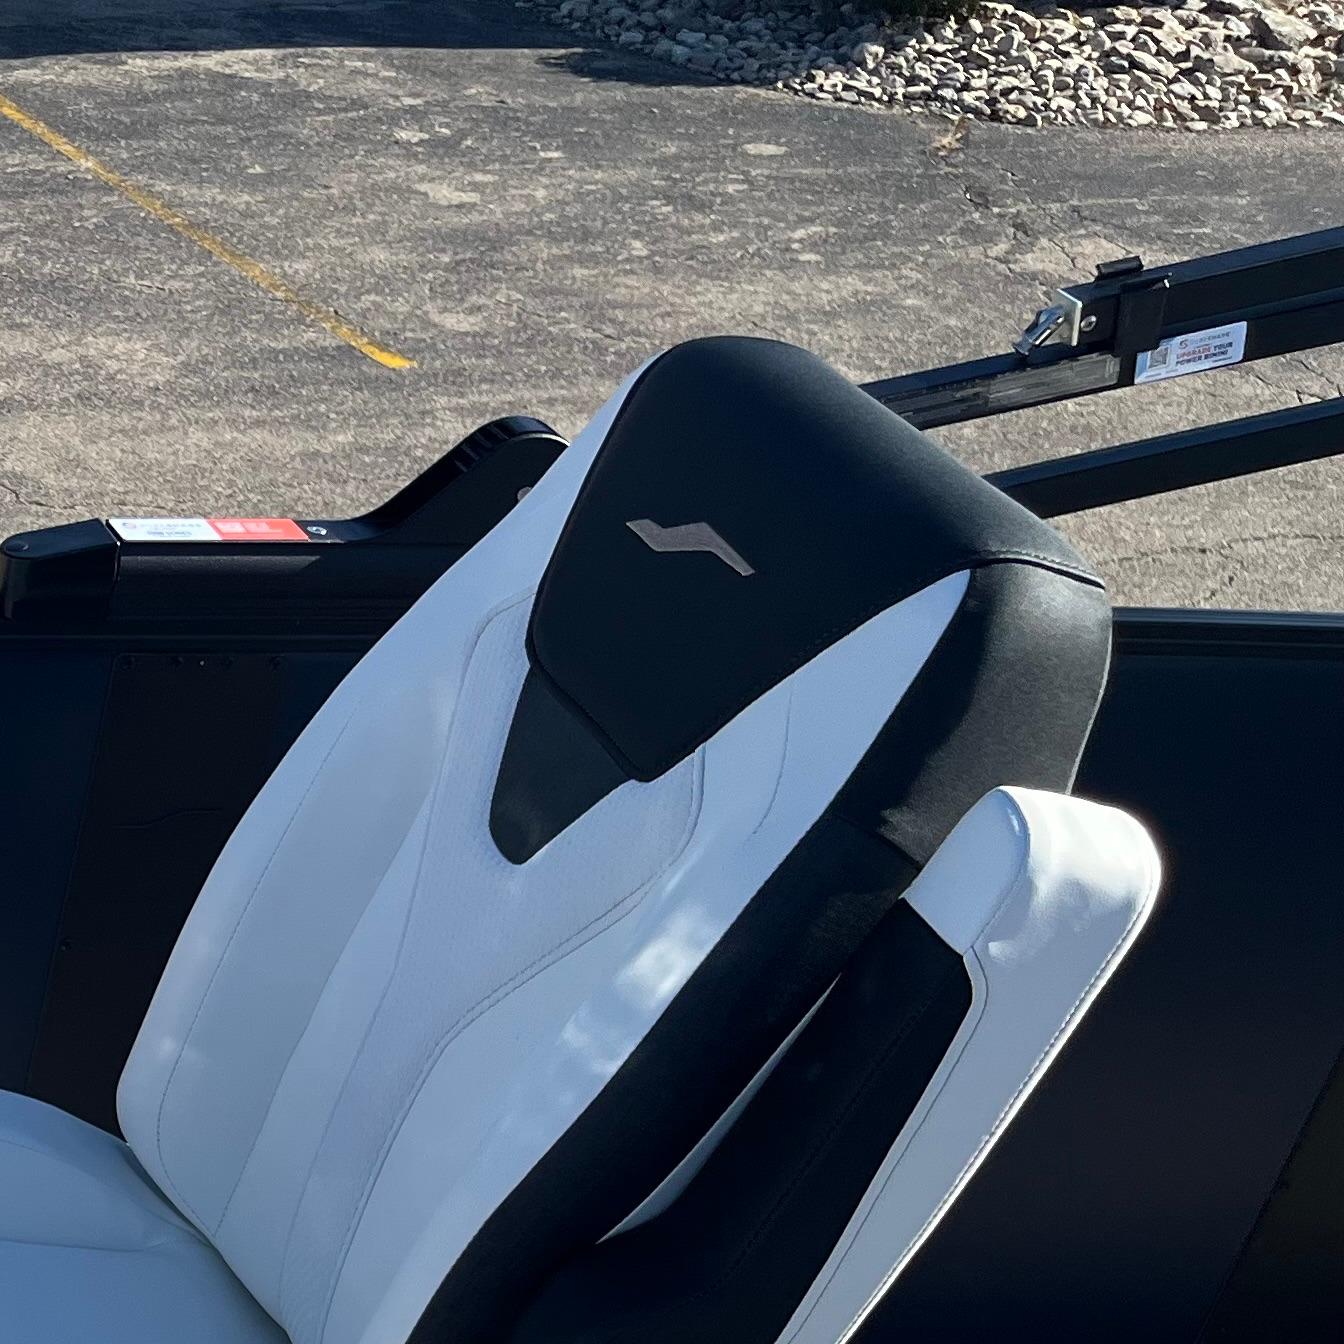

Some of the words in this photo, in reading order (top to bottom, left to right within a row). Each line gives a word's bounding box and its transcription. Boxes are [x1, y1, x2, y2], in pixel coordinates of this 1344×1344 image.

[1176, 346, 1211, 360] UPGRADE
[1214, 342, 1233, 352] YOUR
[1175, 355, 1203, 367] POWER
